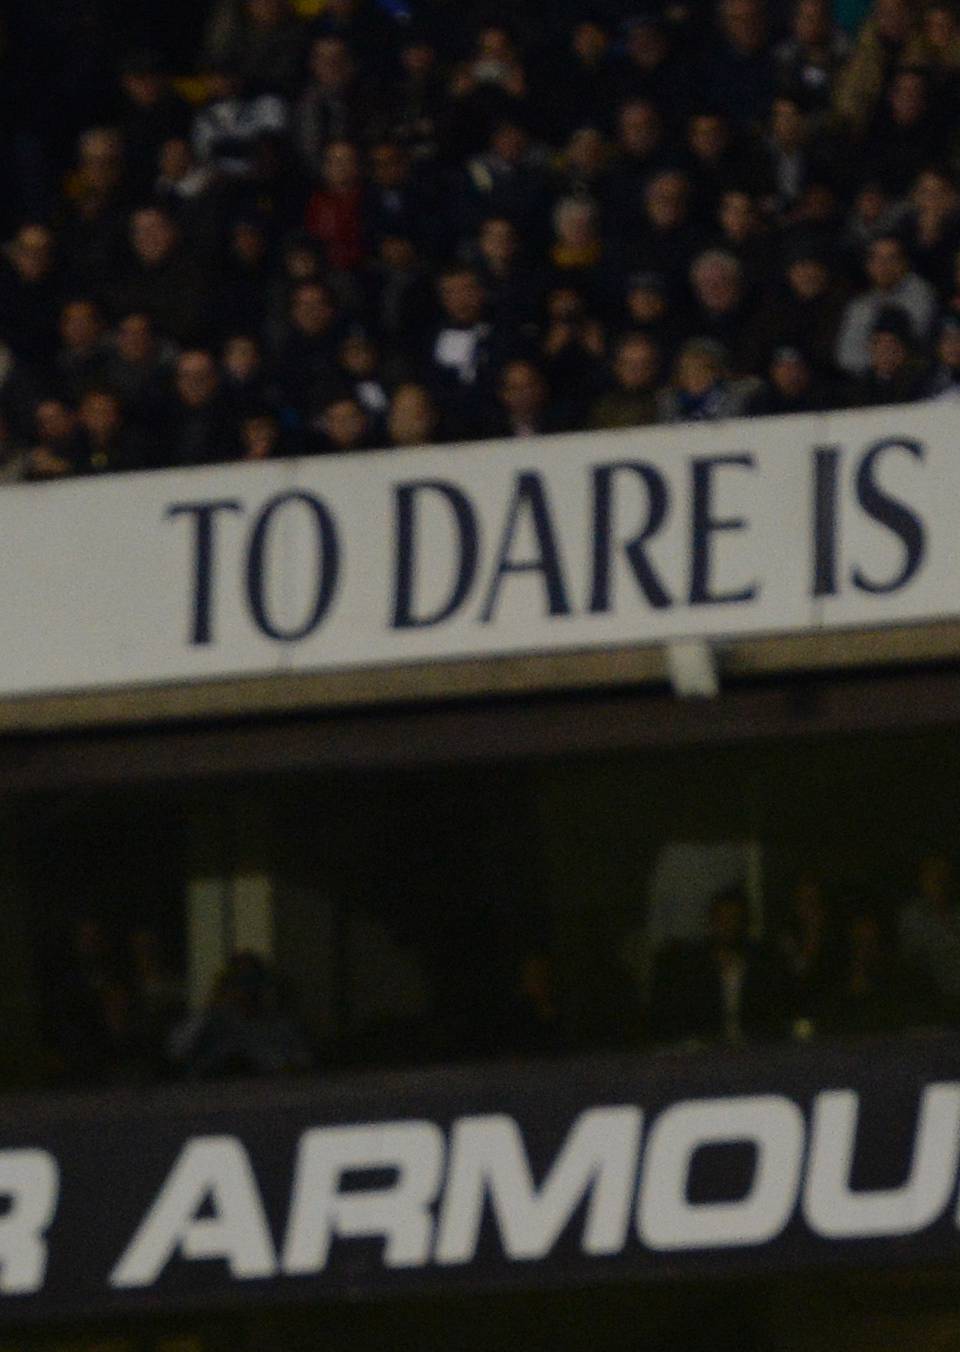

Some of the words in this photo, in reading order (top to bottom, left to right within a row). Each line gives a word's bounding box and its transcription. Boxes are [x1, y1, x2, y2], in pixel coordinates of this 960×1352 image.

[165, 486, 342, 647] TO
[389, 451, 761, 631] DARE
[811, 434, 929, 598] IS
